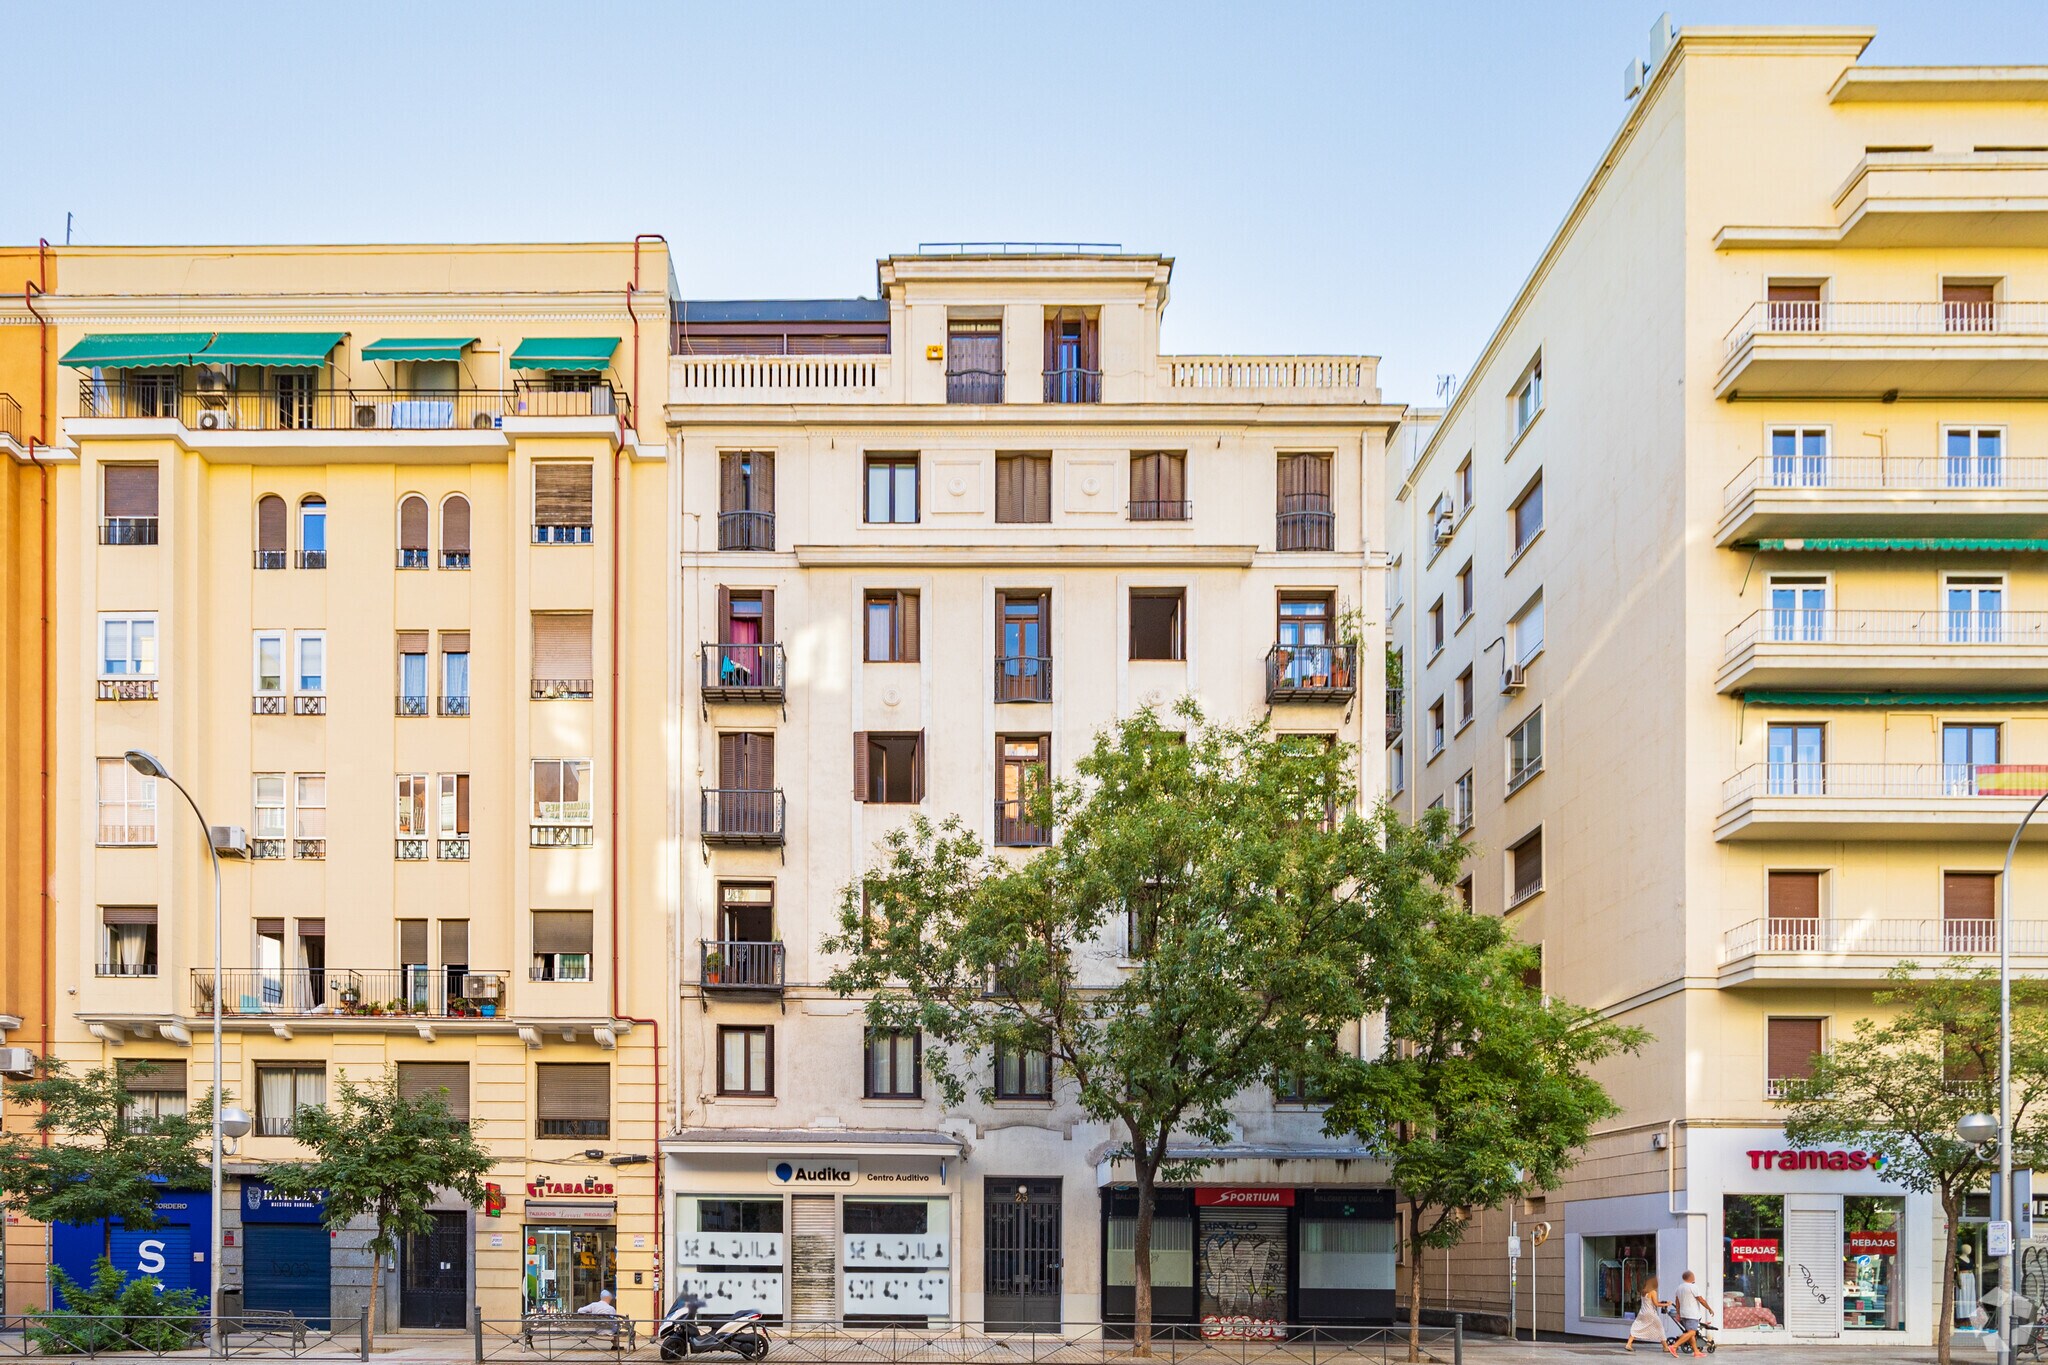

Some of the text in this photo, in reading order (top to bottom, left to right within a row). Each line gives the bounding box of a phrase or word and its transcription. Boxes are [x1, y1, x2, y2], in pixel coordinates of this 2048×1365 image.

[795, 1167, 850, 1181] Audika
[867, 1173, 929, 1182] Centro Auditivo
[545, 1183, 614, 1194] TABACOS
[1015, 1192, 1029, 1203] 25
[1211, 1190, 1280, 1204] SPORTIUM
[1851, 1238, 1896, 1247] REBAJAS
[1732, 1246, 1777, 1255] REBAJAS
